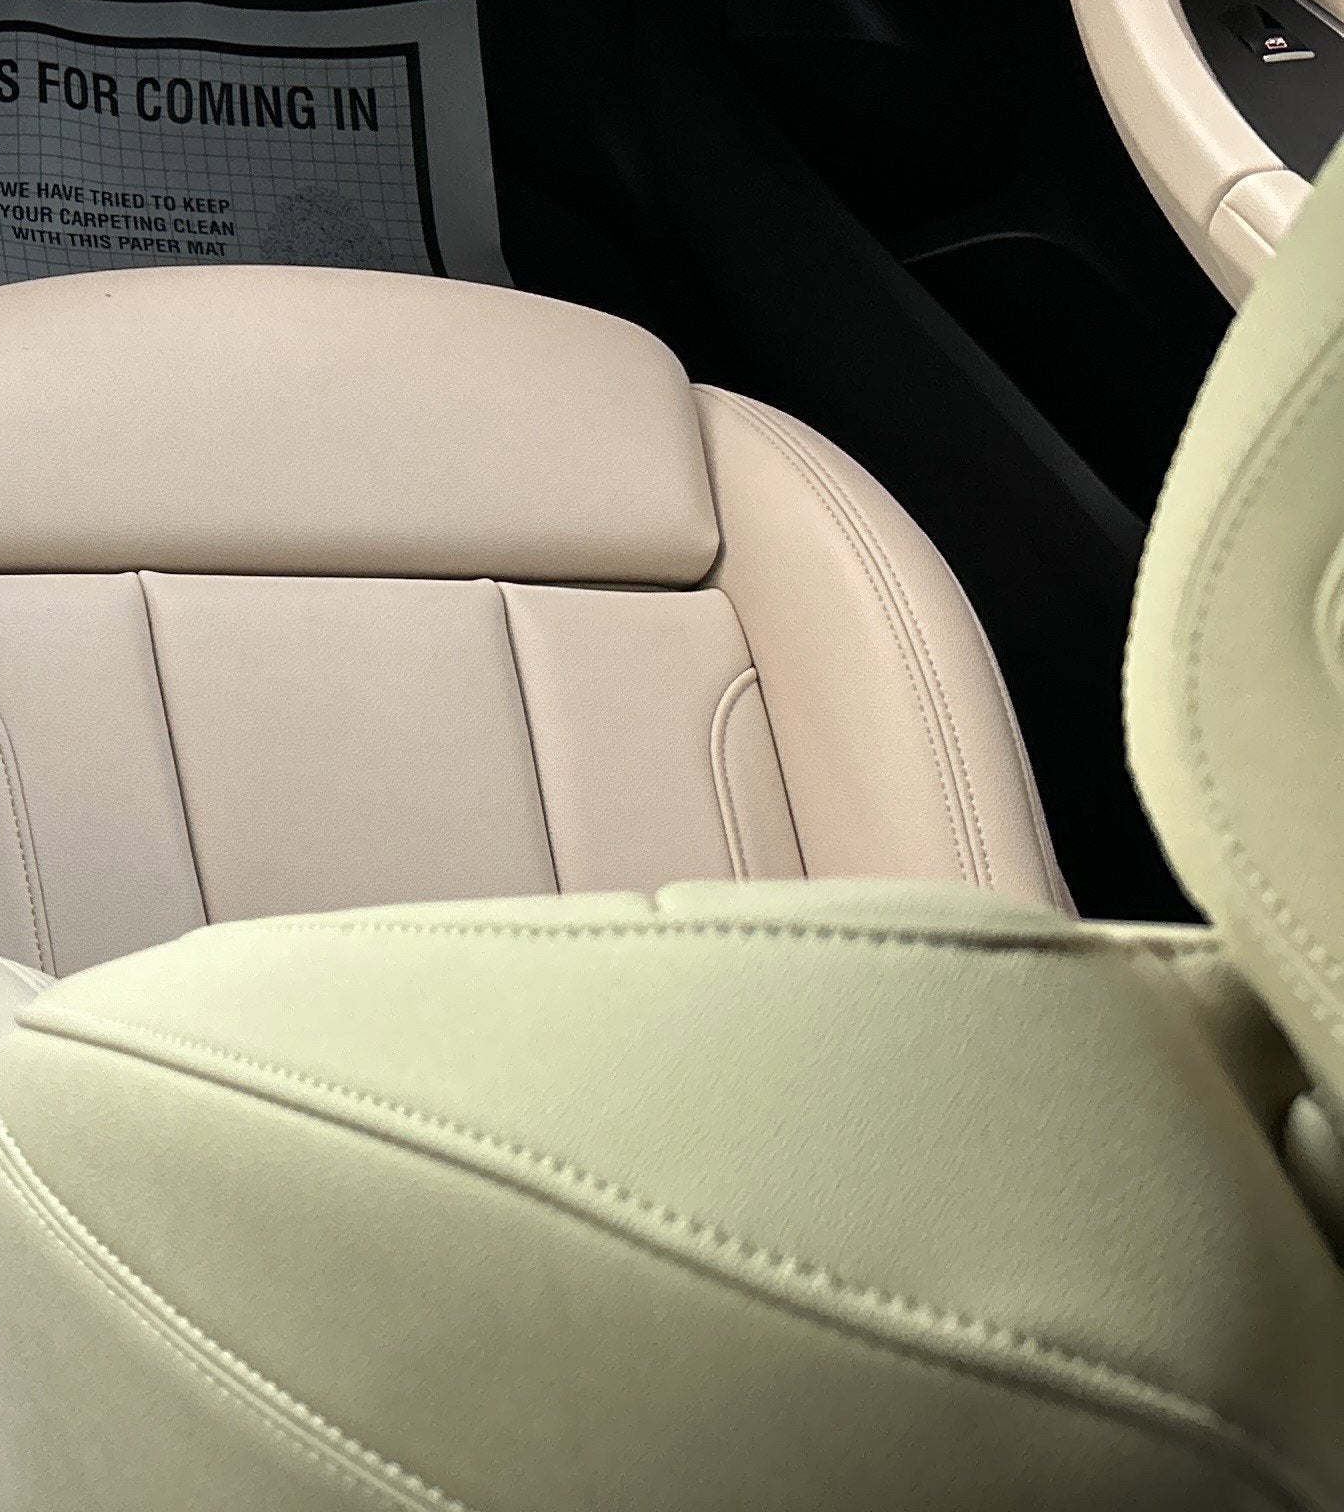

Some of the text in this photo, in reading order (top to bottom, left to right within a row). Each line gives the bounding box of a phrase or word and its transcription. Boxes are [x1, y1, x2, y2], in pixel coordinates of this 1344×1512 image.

[38, 60, 120, 118] FOR
[136, 76, 316, 131] COMING
[334, 86, 379, 132] IN
[0, 181, 230, 215] WE HAVE TRIED TO KEEP
[0, 203, 235, 237] YOUR CARPETING CLEAN
[11, 226, 227, 257] WITH THIS PAPER MAT
